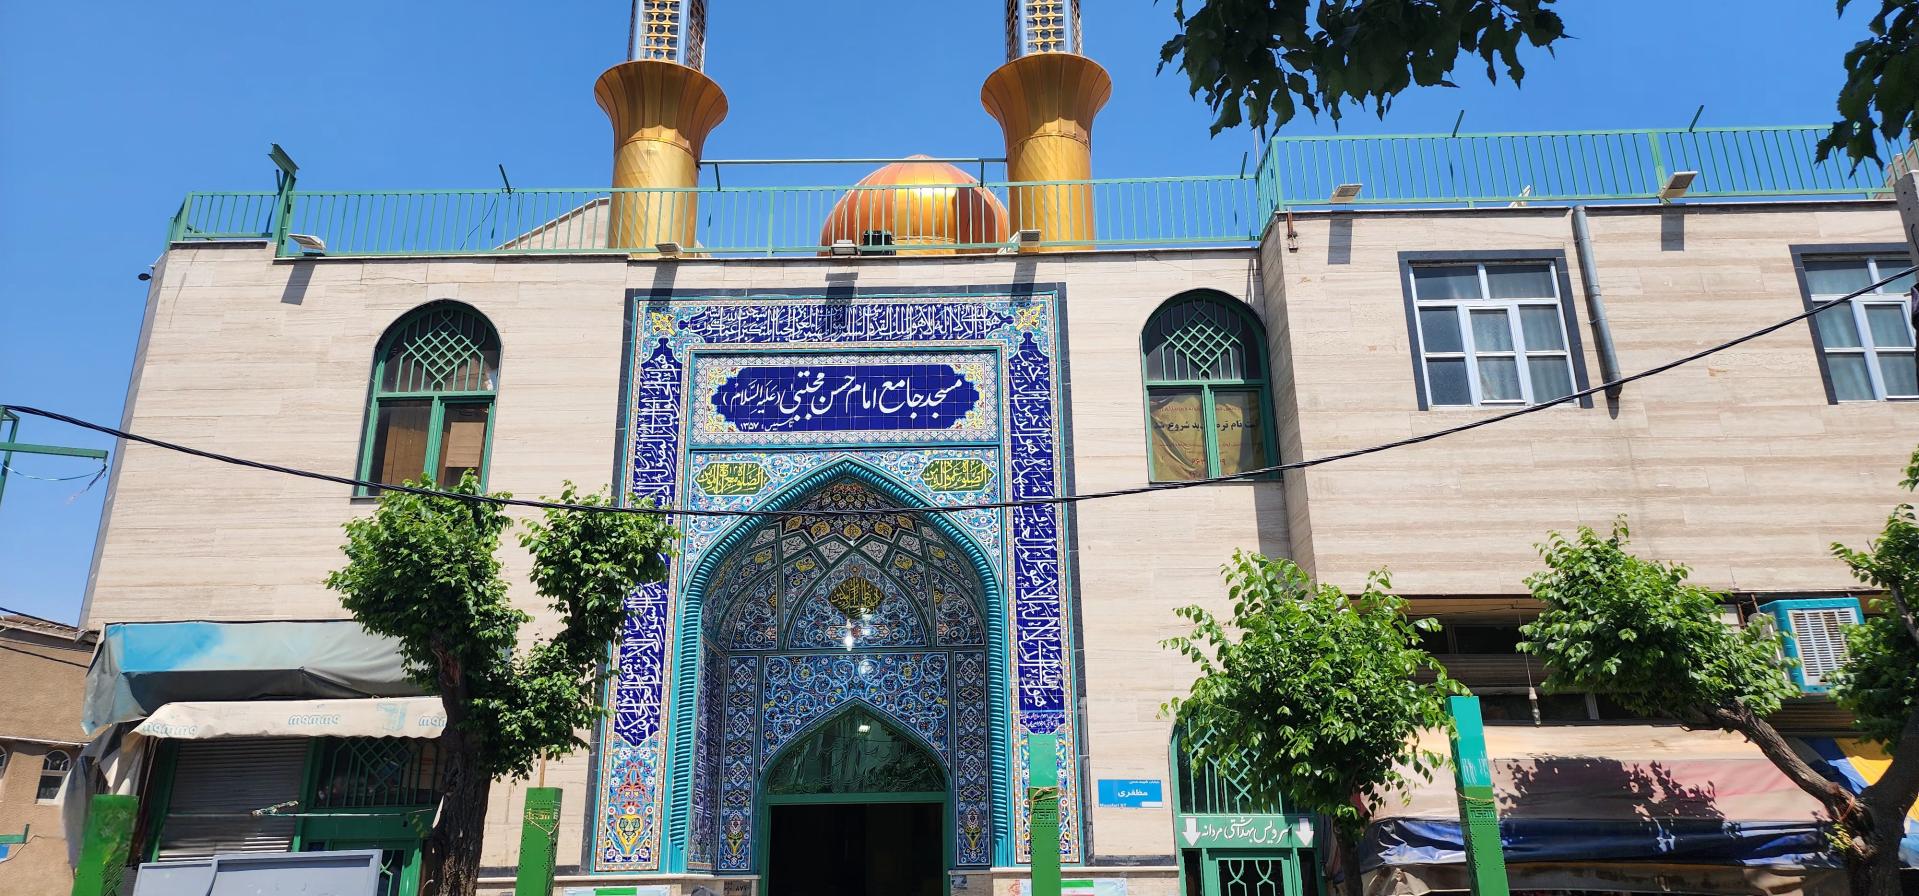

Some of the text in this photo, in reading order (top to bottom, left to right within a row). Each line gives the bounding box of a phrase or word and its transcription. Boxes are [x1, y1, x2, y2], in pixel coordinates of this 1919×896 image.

[811, 375, 855, 415] حسن
[845, 382, 877, 414] امام
[879, 377, 924, 419] جامع
[919, 379, 963, 419] مسجد
[740, 421, 759, 431] ۱۳۵۷
[1117, 788, 1149, 798] مظفری
[1201, 816, 1294, 844] سرویس بهداشتی مردانه
